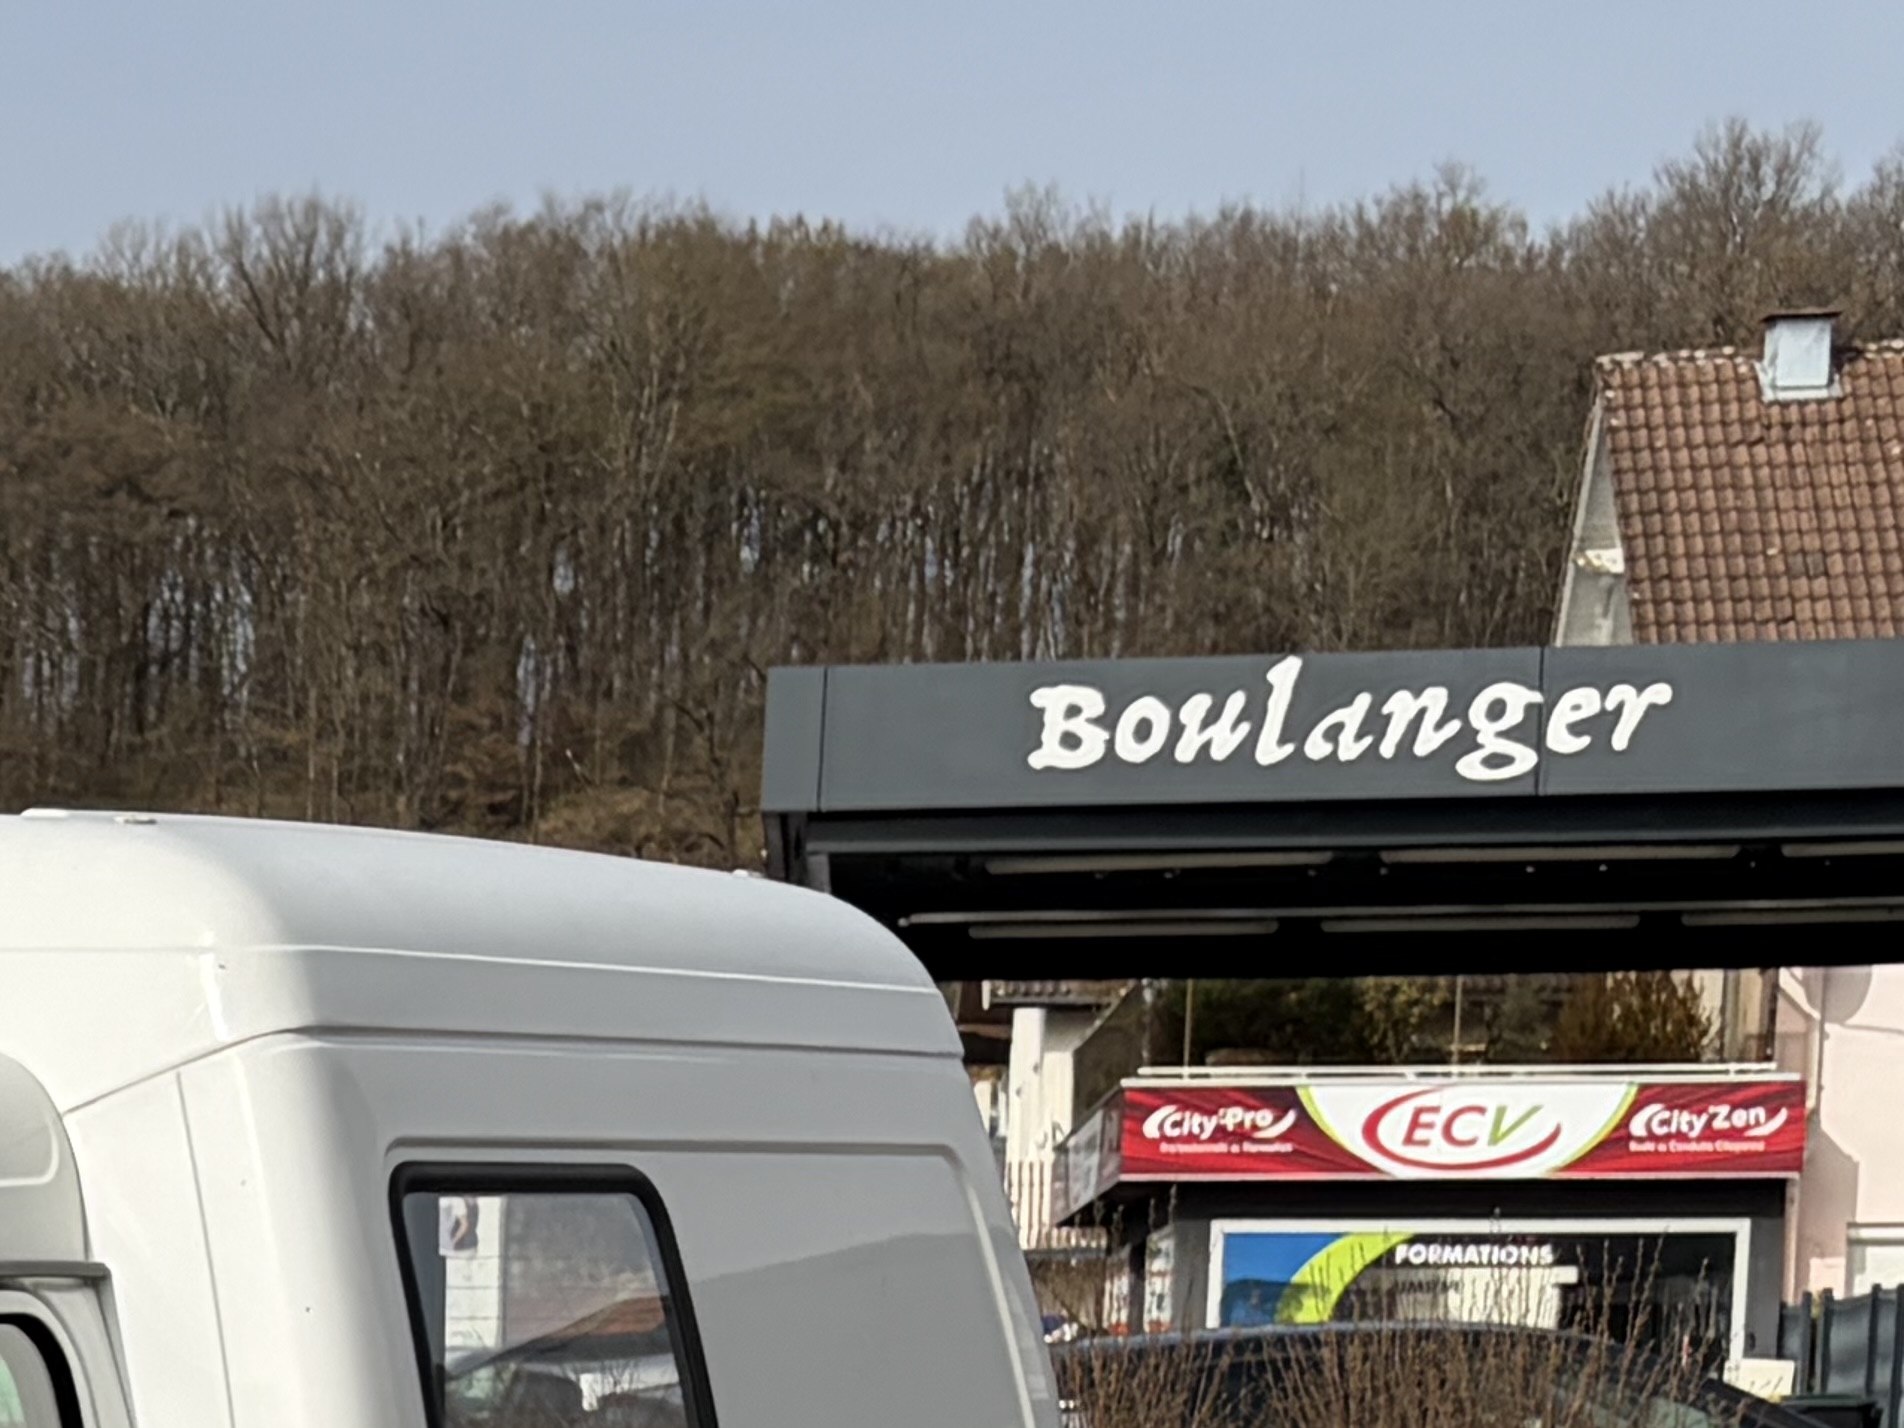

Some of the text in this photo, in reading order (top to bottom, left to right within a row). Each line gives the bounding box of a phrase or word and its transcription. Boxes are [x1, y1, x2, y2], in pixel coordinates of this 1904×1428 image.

[1027, 654, 1673, 782] Boulanger
[1402, 1105, 1543, 1147] ECV
[1395, 1243, 1554, 1266] FORMATIONS
